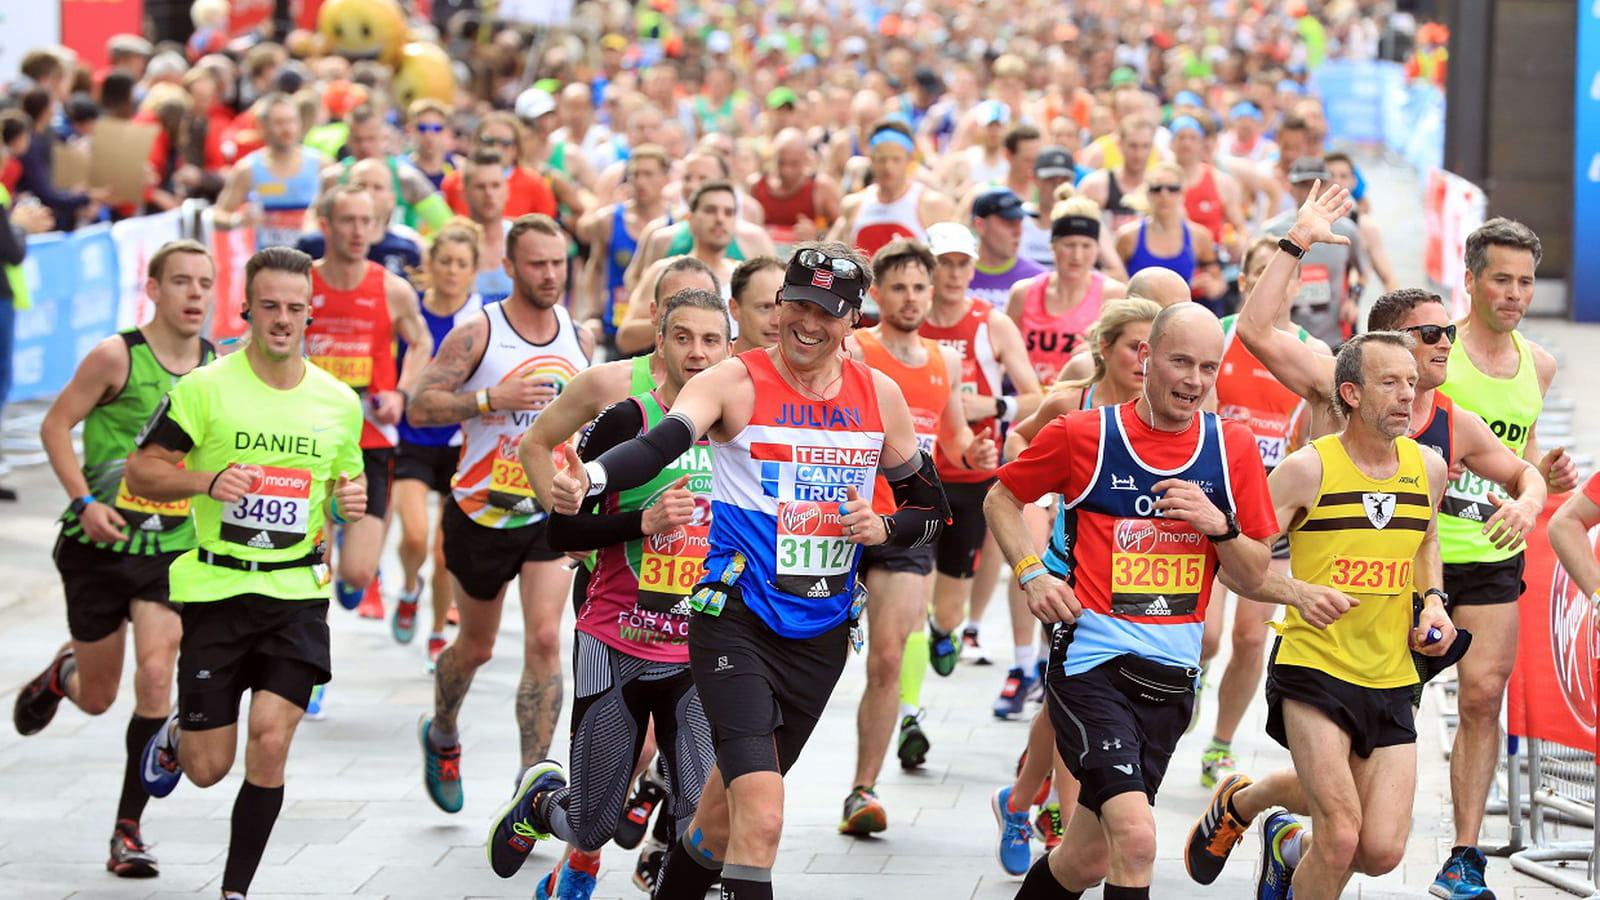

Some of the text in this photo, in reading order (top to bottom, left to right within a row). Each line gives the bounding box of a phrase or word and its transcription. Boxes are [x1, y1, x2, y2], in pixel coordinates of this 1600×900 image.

[1026, 330, 1076, 354] SUZ
[775, 403, 860, 428] JULIAN
[1480, 416, 1527, 444] ODI
[235, 431, 322, 458] DANIEL
[796, 447, 879, 466] TEENAGE
[665, 448, 712, 471] HA
[265, 473, 308, 490] money
[796, 484, 859, 502] TRUS
[232, 496, 297, 526] 3493
[784, 504, 820, 532] Virgin
[651, 529, 686, 553] Virgin
[1119, 520, 1203, 551] Virgin money
[780, 538, 856, 568] 31127
[1115, 556, 1201, 587] 32615
[1332, 558, 1410, 588] 32310
[807, 589, 831, 598] adidas
[617, 611, 656, 631] FOR
[662, 622, 674, 635] A
[1145, 608, 1172, 616] adidas
[619, 625, 667, 645] WITH
